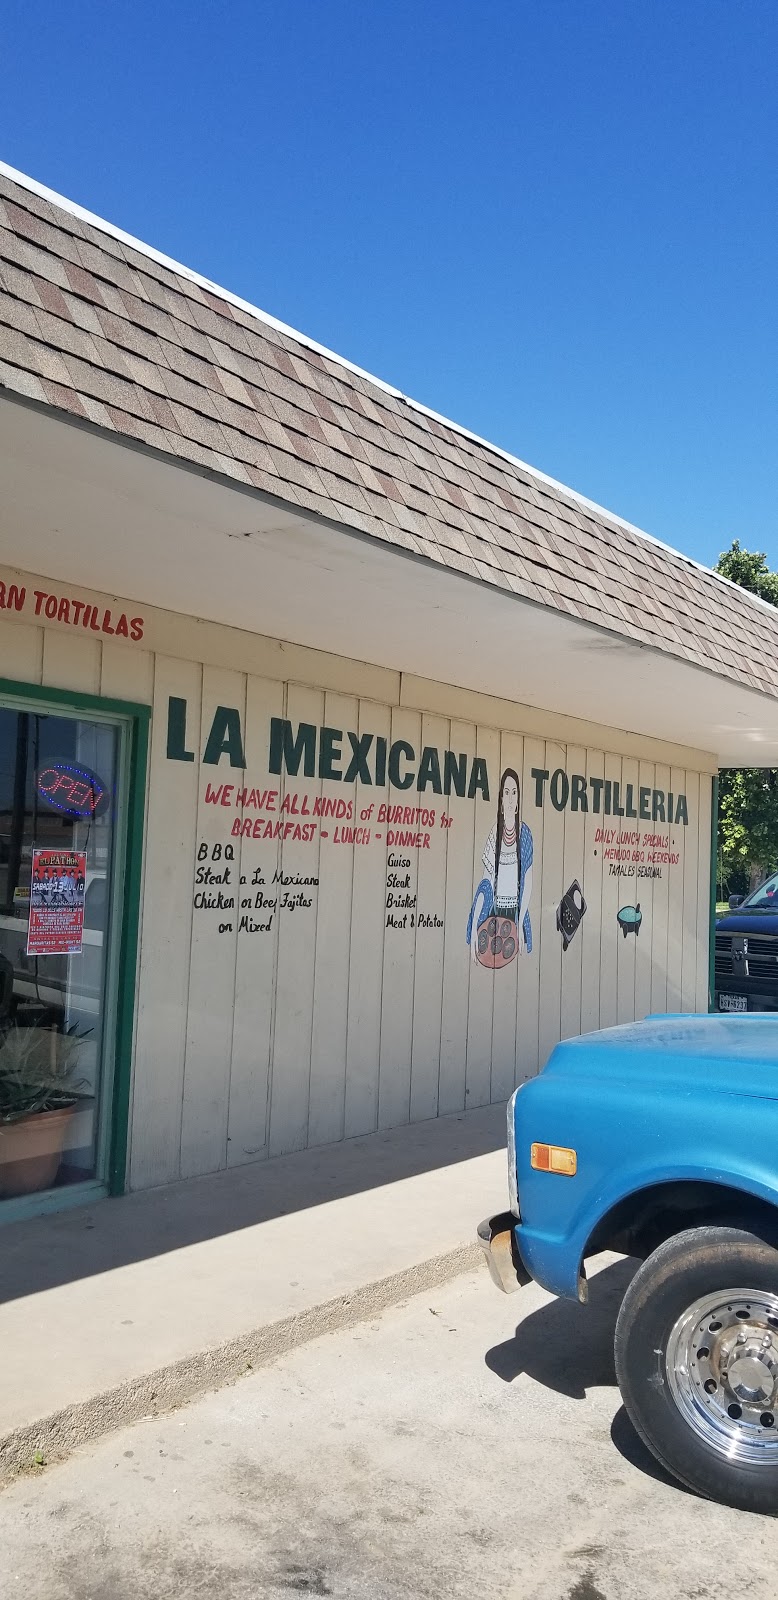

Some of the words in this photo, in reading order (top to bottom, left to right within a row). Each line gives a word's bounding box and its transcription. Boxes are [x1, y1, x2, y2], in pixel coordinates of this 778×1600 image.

[34, 591, 144, 641] TORTILLAS
[166, 696, 247, 769] LA
[268, 717, 491, 802] MEXICANA
[531, 768, 689, 826] TORTILLERIA
[38, 769, 104, 811] OPEN
[205, 783, 234, 807] WE
[236, 788, 278, 811] HAVE
[280, 793, 310, 816] ALL
[312, 797, 353, 820] KINDS
[360, 803, 375, 820] of
[377, 804, 436, 827] BURRITOS
[231, 818, 317, 842] BREAKFAST
[333, 826, 371, 845] LUNCH
[386, 830, 430, 849] DINNER
[594, 828, 615, 844] DAILY
[616, 831, 640, 845] LUNCH
[642, 834, 669, 849] SPECIALS
[387, 852, 411, 868] Guiso
[603, 848, 630, 862] MENUDO
[647, 851, 680, 865] WEEKENDS
[195, 866, 232, 885] Steak
[251, 867, 266, 886] La
[271, 869, 319, 886] Mexicana
[608, 863, 635, 877] TAMALES
[637, 865, 662, 879] SEASONAL
[54, 881, 64, 893] 13
[64, 883, 84, 891] JULIO
[386, 873, 411, 889] Steak
[193, 891, 235, 910] Chicken
[254, 891, 278, 914] Beef
[280, 892, 313, 912] Fajitas
[385, 892, 417, 909] Brisket
[238, 915, 273, 933] Mixed
[385, 914, 408, 929] Meat
